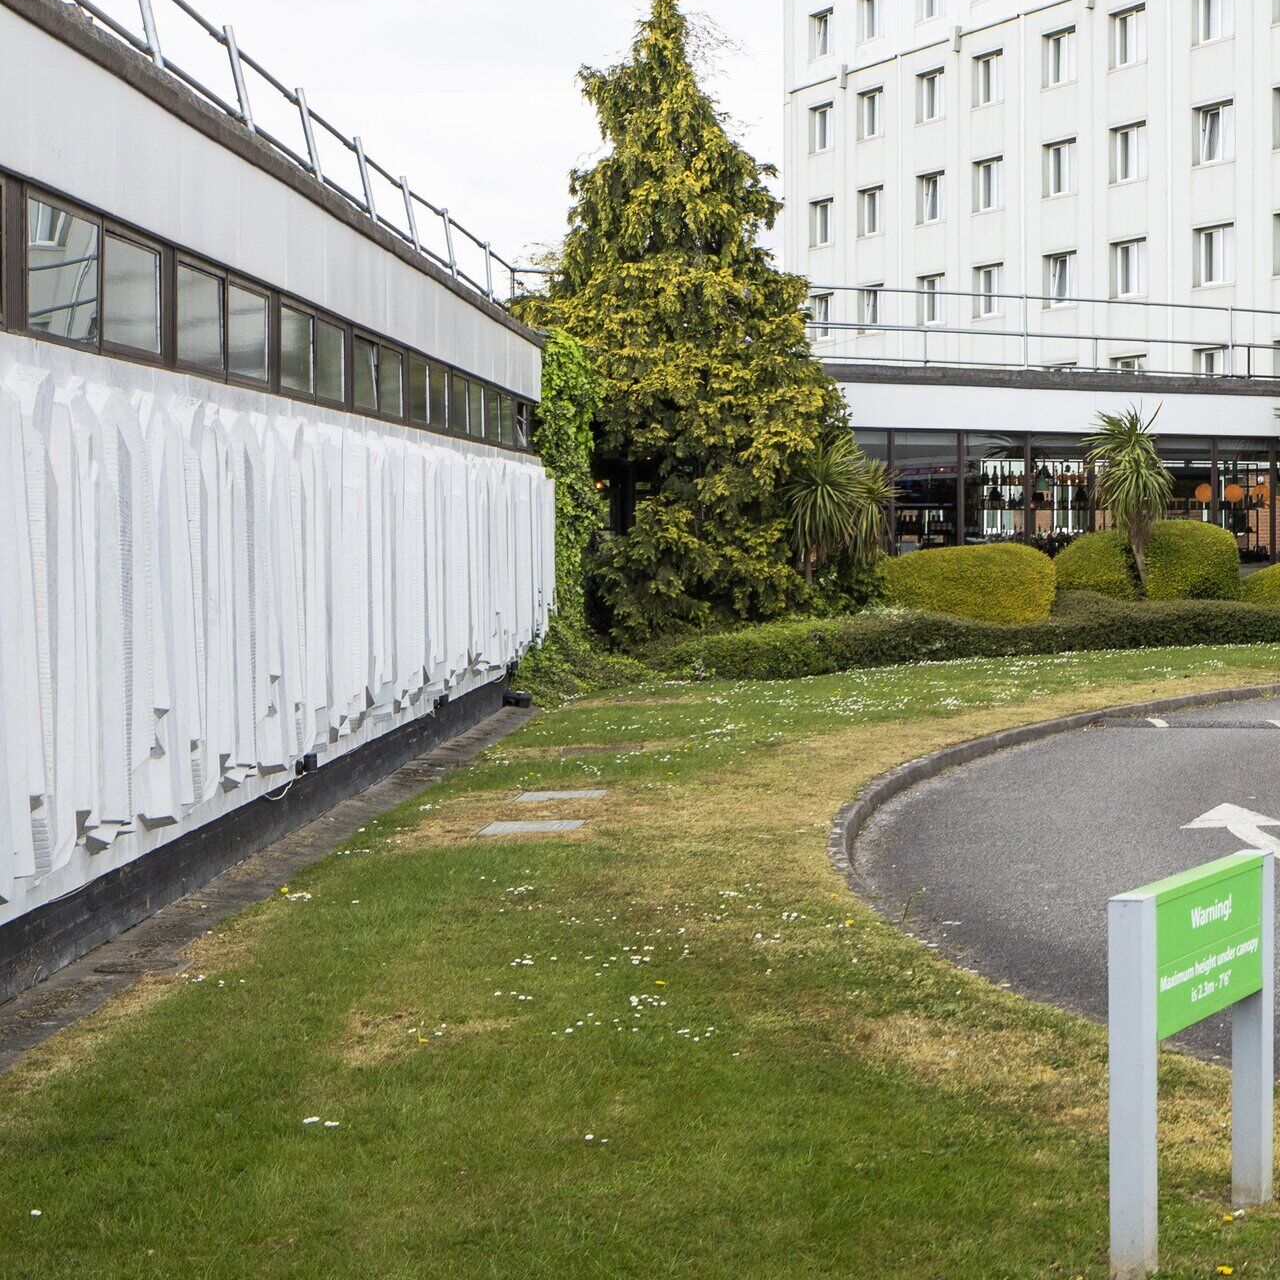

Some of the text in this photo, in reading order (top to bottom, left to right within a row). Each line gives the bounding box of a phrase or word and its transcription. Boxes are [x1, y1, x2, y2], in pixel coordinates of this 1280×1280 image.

[1191, 893, 1232, 929] Warning!
[1160, 937, 1259, 993] Maximum height under canopy
[1191, 987, 1198, 1002] is
[1198, 981, 1215, 1000] 2.3m
